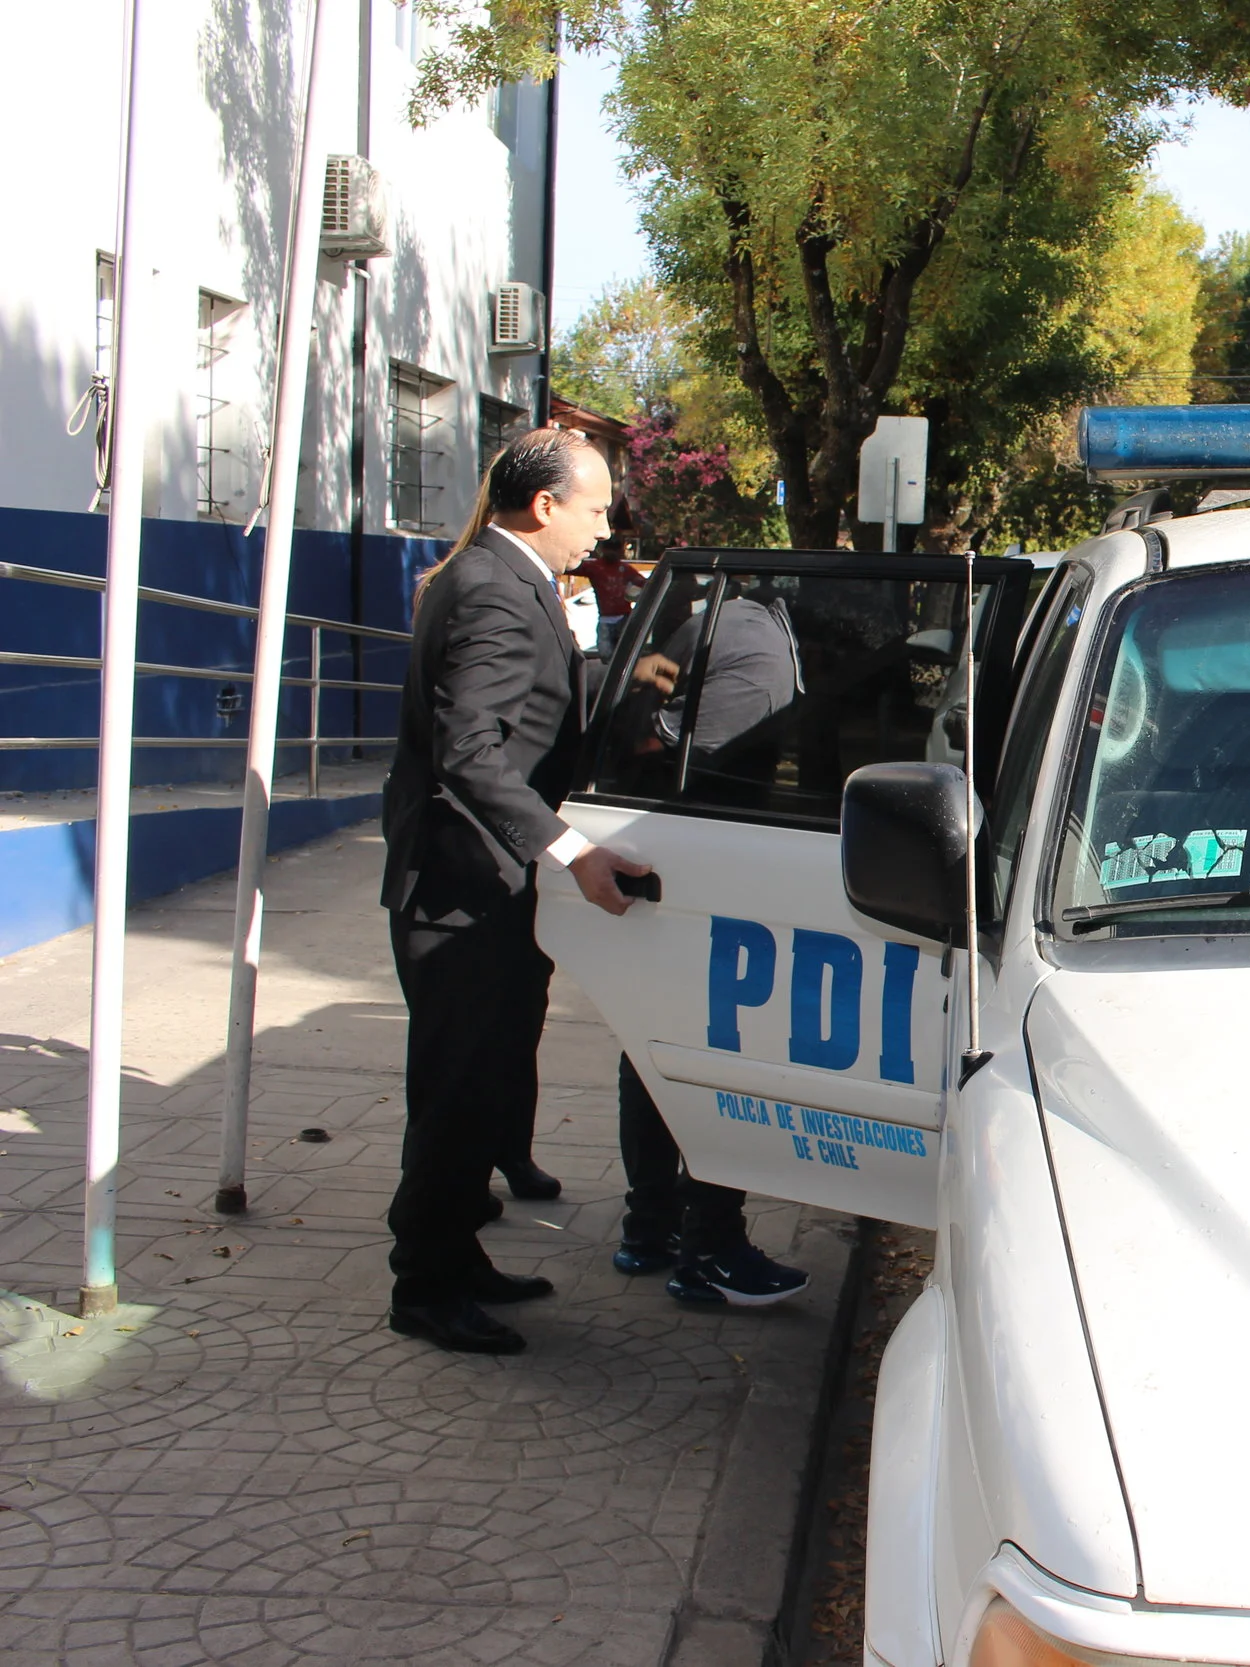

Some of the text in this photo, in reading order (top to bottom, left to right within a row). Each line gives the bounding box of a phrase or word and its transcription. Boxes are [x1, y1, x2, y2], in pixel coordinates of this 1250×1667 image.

[707, 915, 920, 1084] PDI
[716, 1091, 927, 1157] POLICIA DE INVESTIGACIONES
[792, 1135, 859, 1170] DE CHILE
